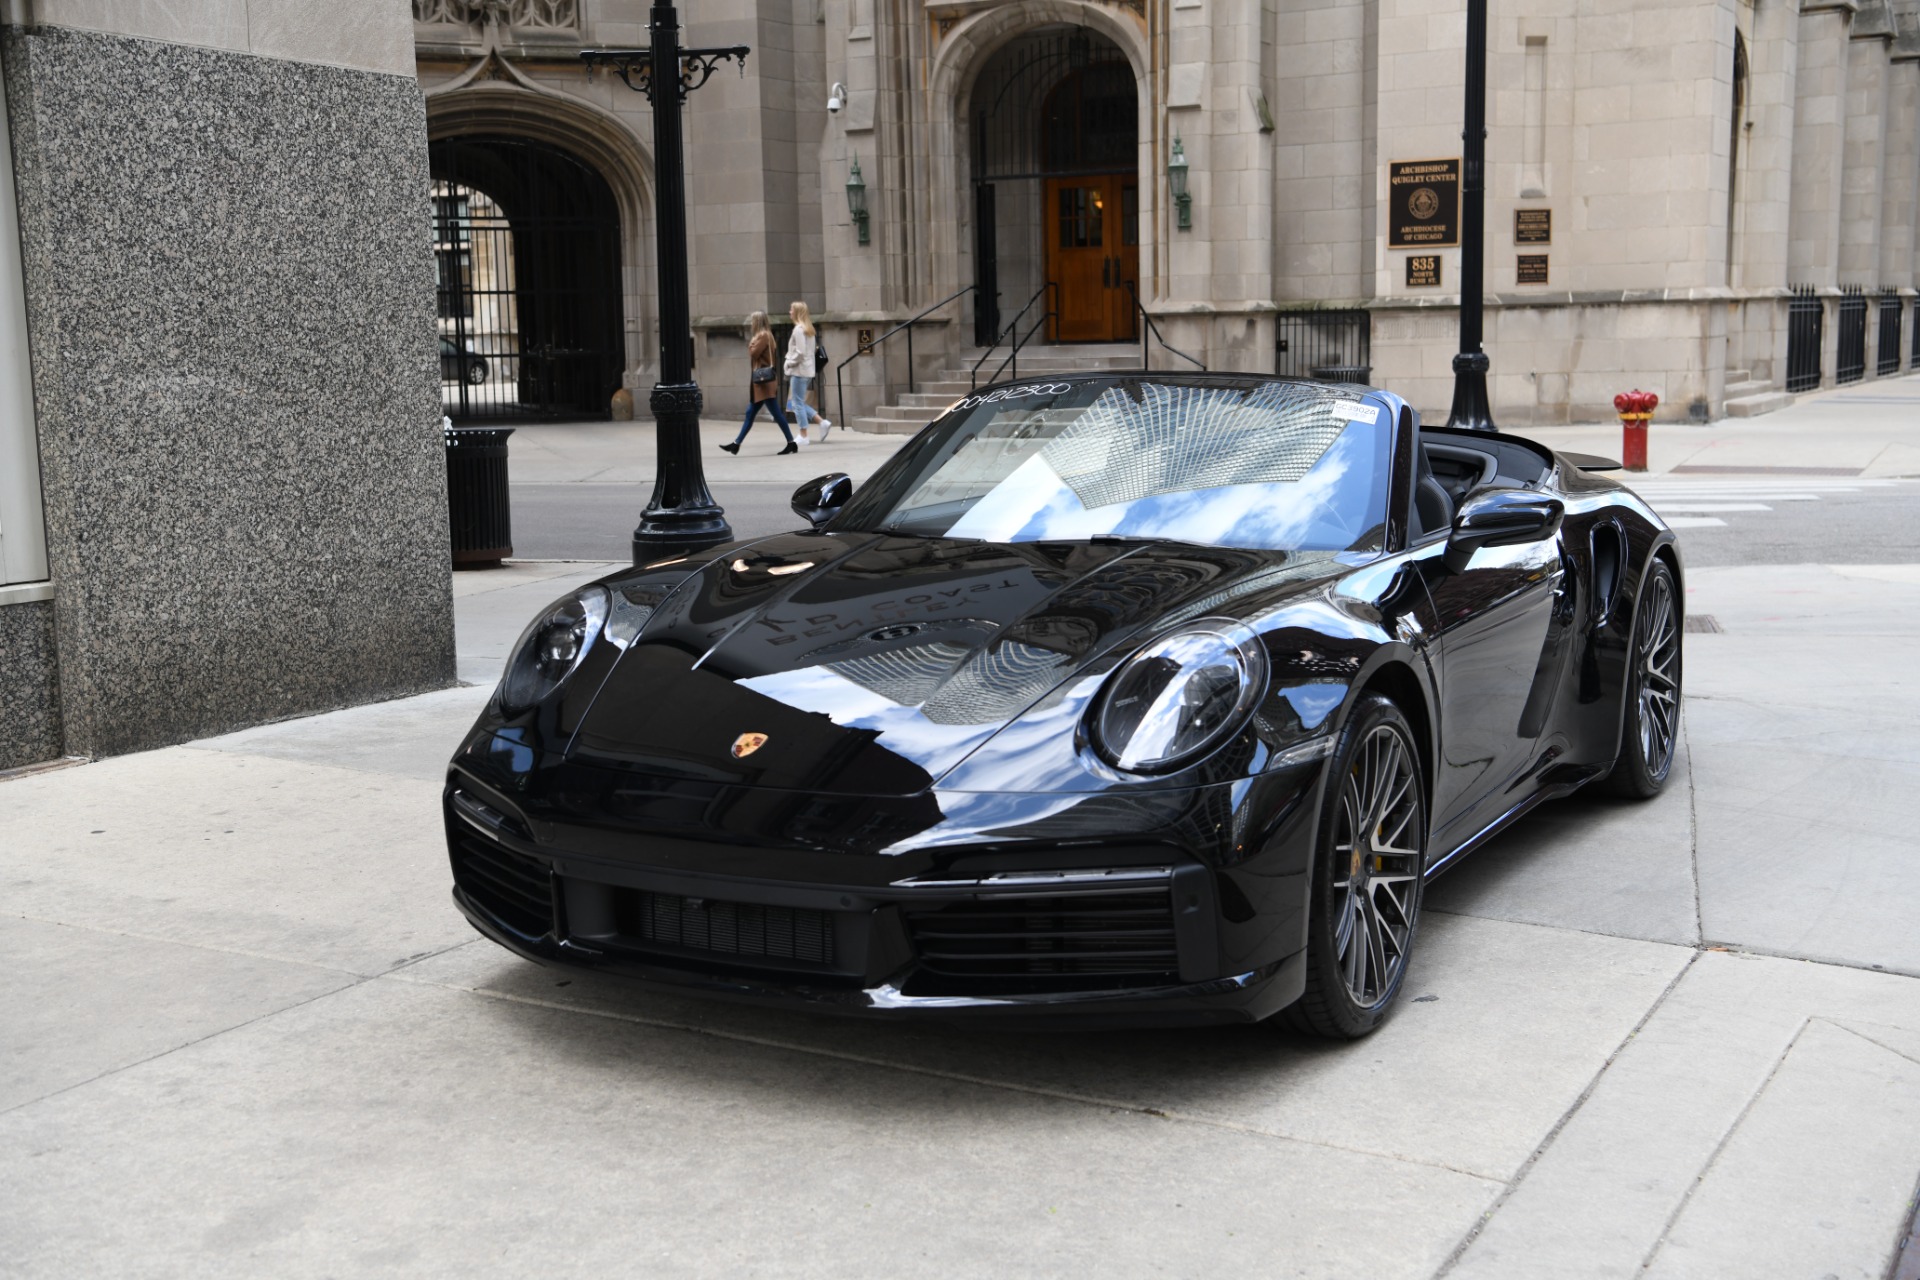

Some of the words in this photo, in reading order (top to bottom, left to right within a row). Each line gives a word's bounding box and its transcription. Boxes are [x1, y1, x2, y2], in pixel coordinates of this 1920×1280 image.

[1400, 164, 1449, 174] ARCHBISHOP
[1392, 175, 1425, 185] QUIGLEY
[1426, 173, 1456, 182] CENTER
[1401, 225, 1446, 233] ARCHDIOCESE
[1413, 233, 1443, 241] CHICAGO
[1412, 257, 1435, 271] 835
